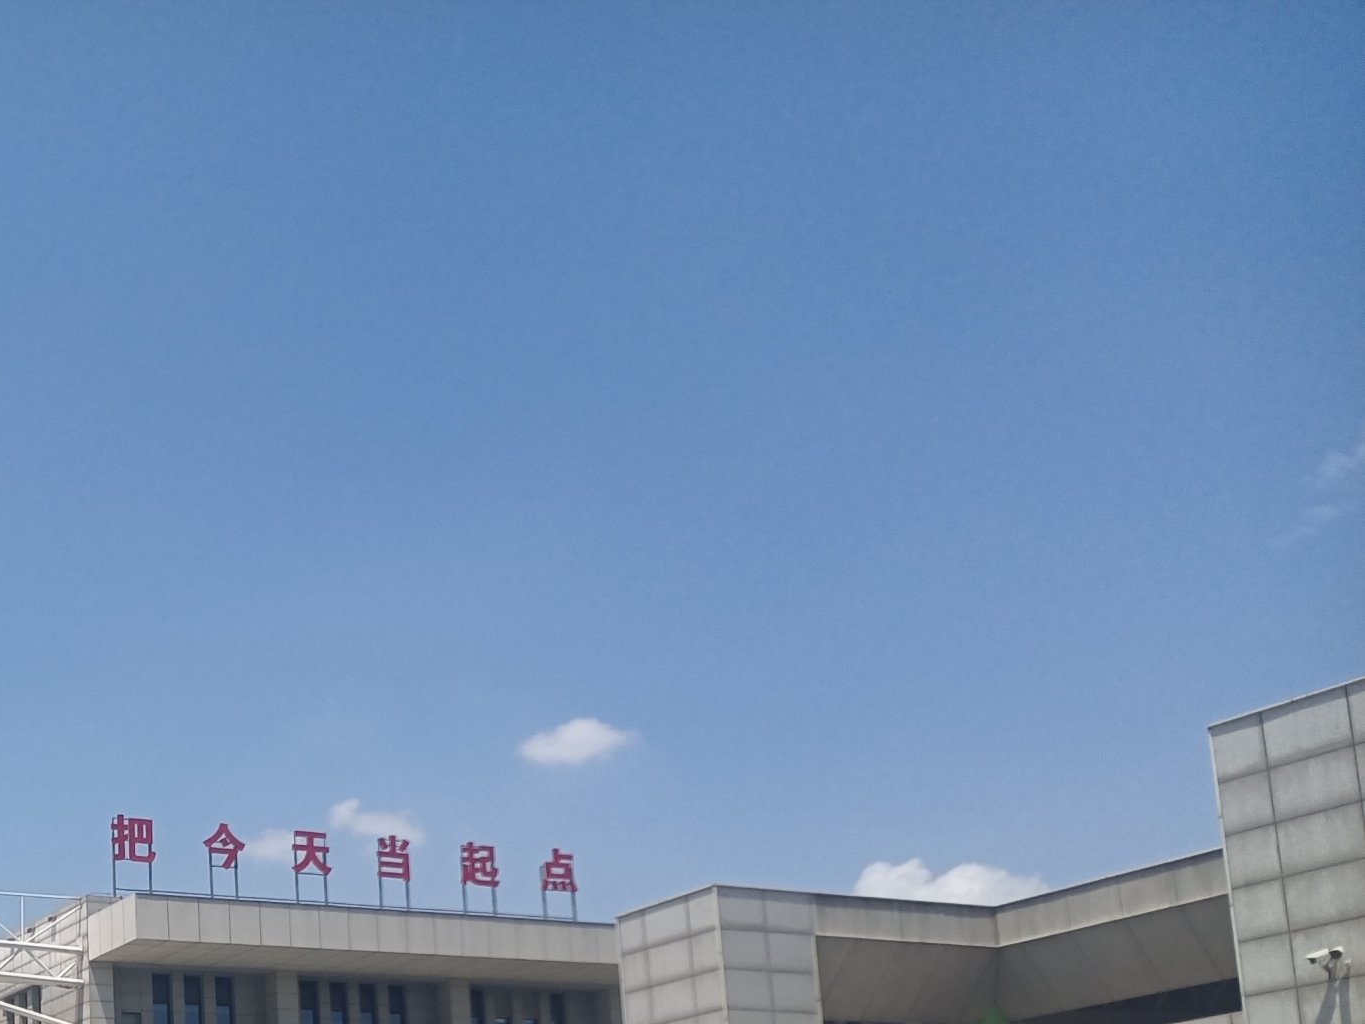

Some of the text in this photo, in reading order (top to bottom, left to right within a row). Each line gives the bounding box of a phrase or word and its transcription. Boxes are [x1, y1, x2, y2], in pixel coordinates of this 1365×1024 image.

[111, 814, 578, 892] 把今天当起点
